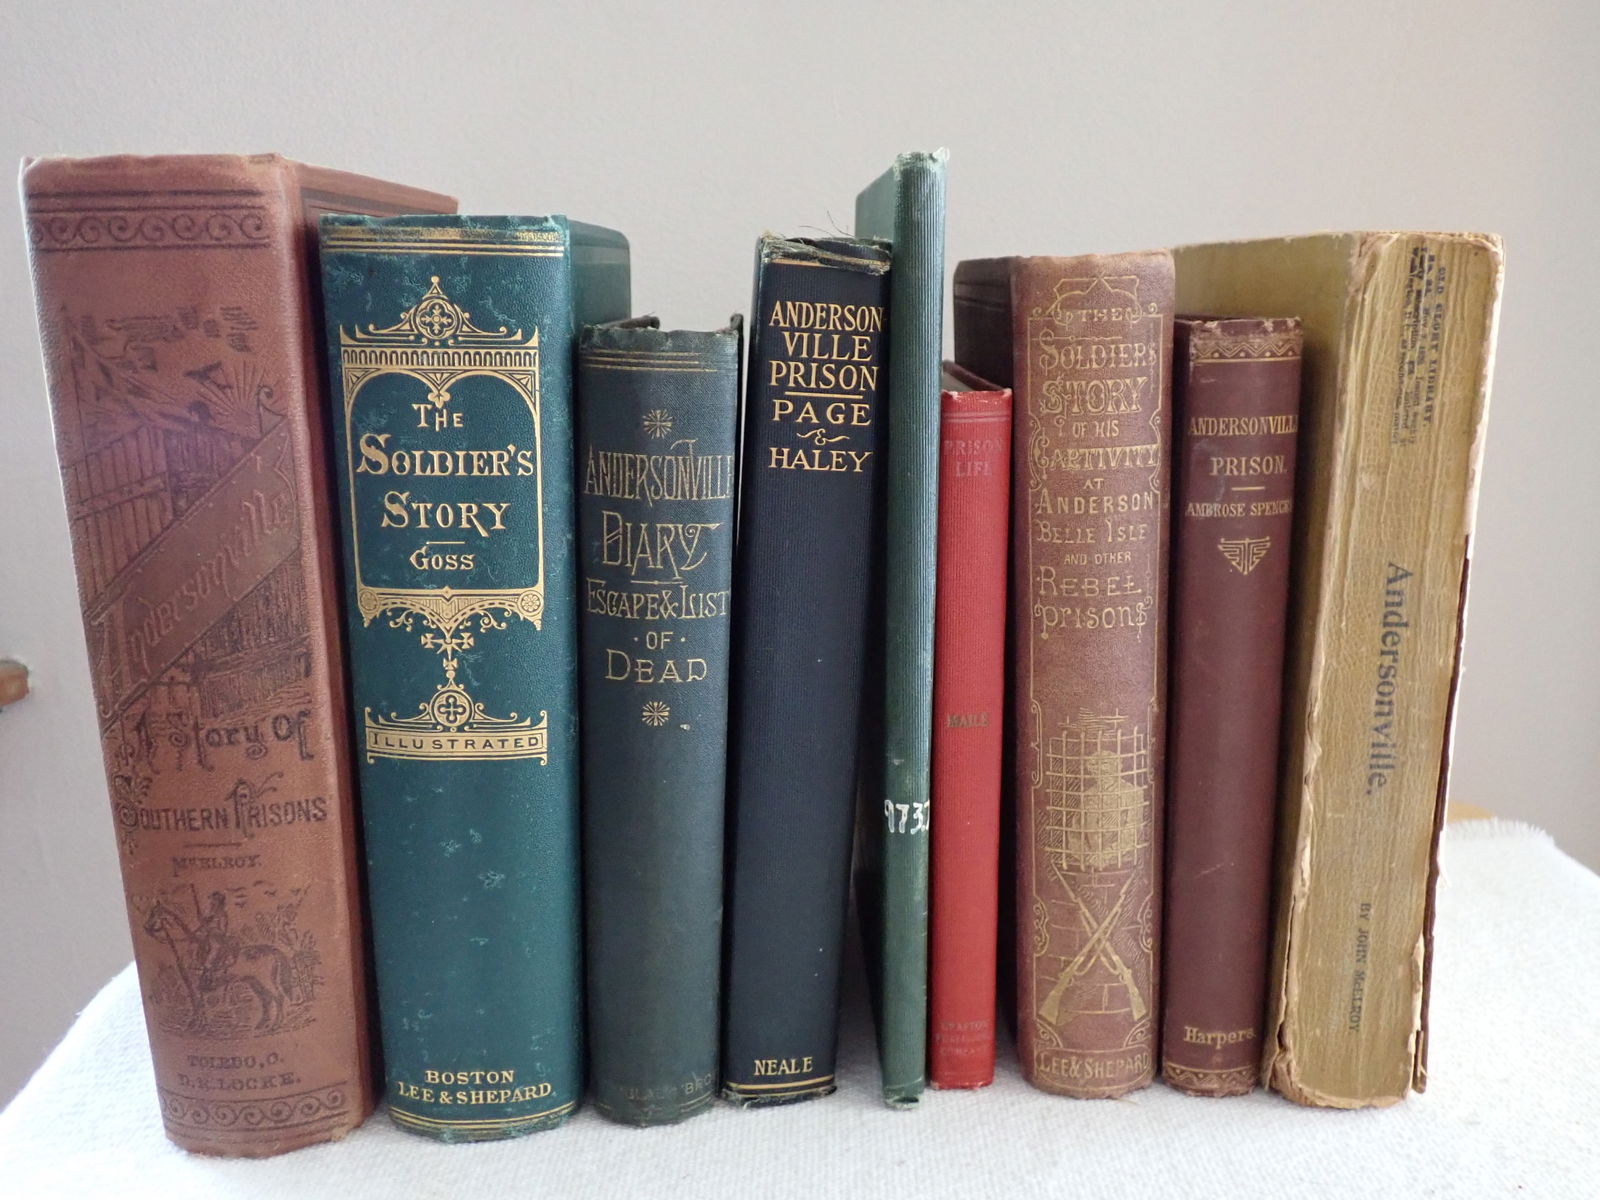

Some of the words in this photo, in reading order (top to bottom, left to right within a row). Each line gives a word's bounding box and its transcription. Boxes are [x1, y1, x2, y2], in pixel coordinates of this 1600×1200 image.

[769, 300, 884, 333] ANDERSON
[1079, 308, 1123, 322] THE
[782, 331, 873, 362] VILLE
[769, 360, 879, 391] PRISON
[1040, 376, 1148, 416] STORY
[412, 403, 464, 431] THE
[772, 399, 873, 426] PAGE
[1072, 421, 1089, 438] OF
[1095, 420, 1120, 437] HIS
[356, 433, 534, 476] SOLDIER'S
[768, 447, 873, 473] HALEY
[1036, 437, 1160, 471] CAPTIVITY
[1083, 478, 1105, 489] AT
[381, 491, 510, 537] STORY
[1185, 502, 1247, 517] AMBROSE
[1036, 520, 1096, 543] BELLE
[1106, 519, 1148, 542] ISLE
[410, 546, 475, 571] GOSS
[602, 511, 724, 580] DIARY
[1064, 554, 1088, 565] AND
[1094, 551, 1131, 564] OTHER
[1037, 566, 1142, 597] REBEL
[646, 631, 674, 650] OF
[605, 649, 707, 684] DEAD
[1366, 562, 1414, 797] Andersonville.
[163, 710, 268, 772] Story
[372, 731, 541, 750] ILLUSTRATED
[227, 776, 328, 838] PRISONS
[1359, 902, 1371, 921] BY
[1355, 927, 1369, 965] JOHN
[425, 1070, 515, 1085] BOSTON
[753, 1056, 813, 1077] NEALE
[398, 1081, 435, 1103] LEE
[439, 1091, 453, 1104] &
[456, 1083, 552, 1104] SHEPARD
